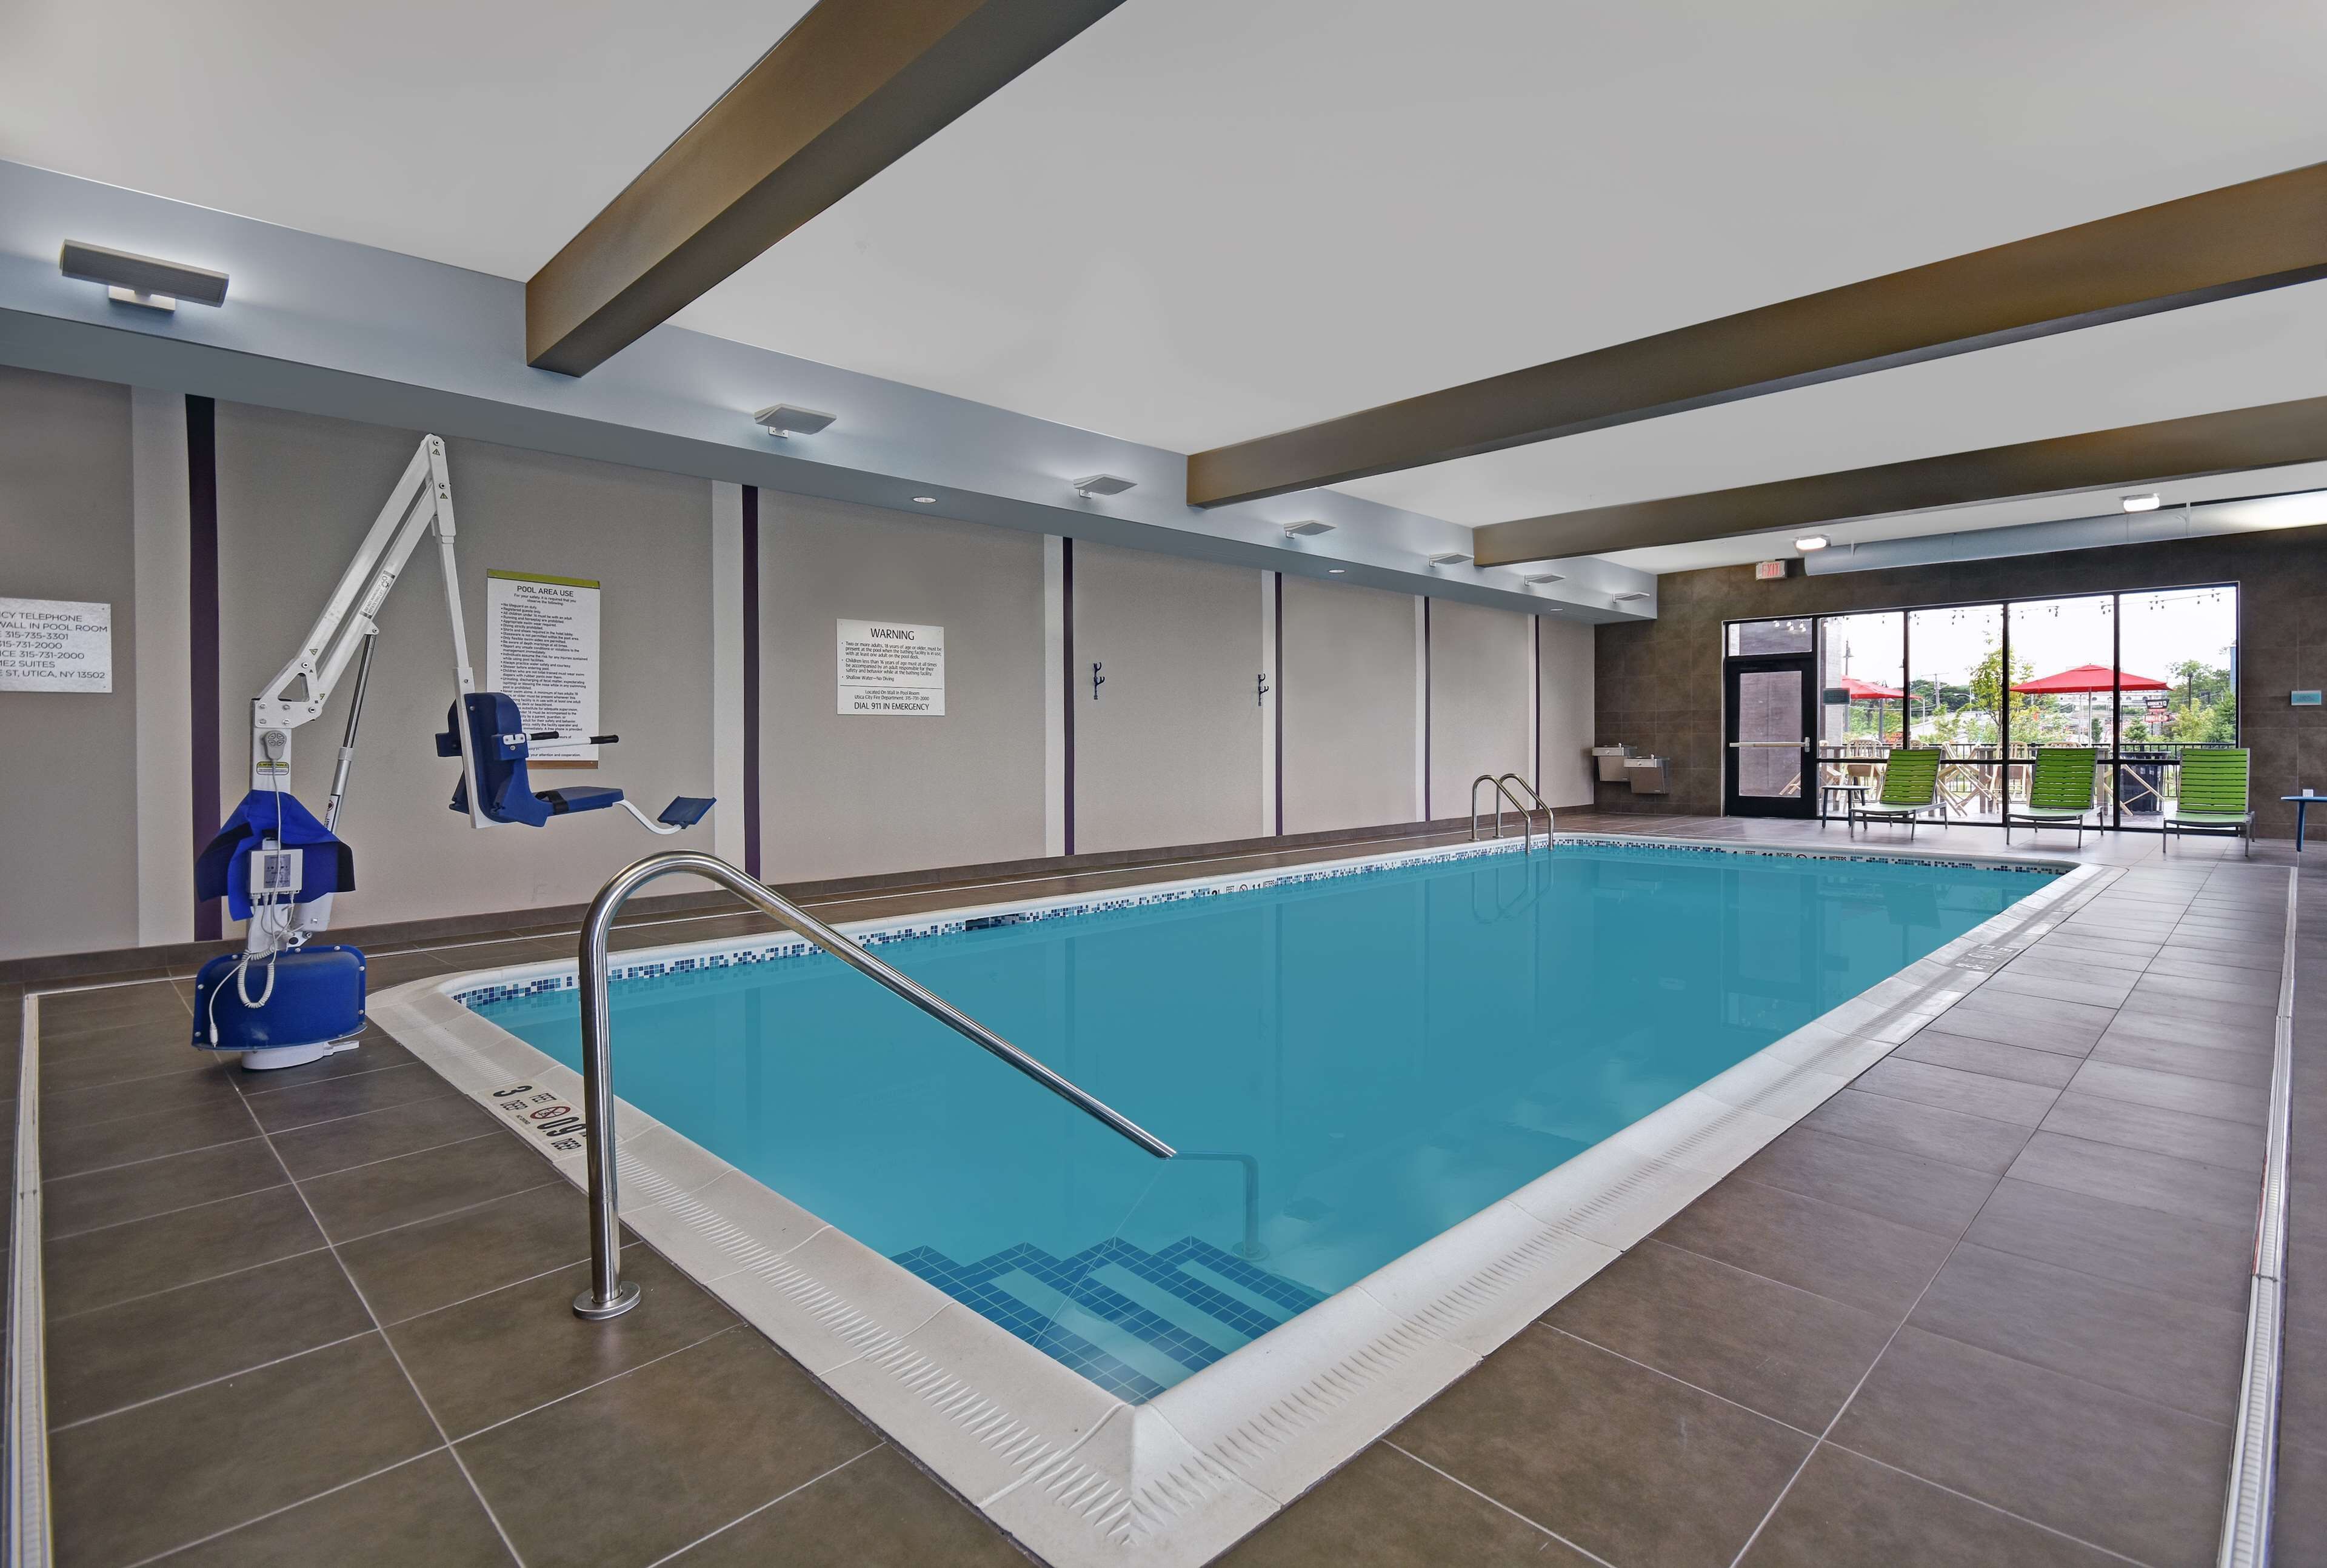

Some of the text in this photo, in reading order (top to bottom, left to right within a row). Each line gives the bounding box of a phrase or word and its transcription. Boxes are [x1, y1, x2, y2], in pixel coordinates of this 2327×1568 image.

[1762, 562, 1780, 576] EXIT
[19, 613, 82, 622] TELEPHONE
[5, 631, 68, 640] 315-735-3301
[870, 628, 915, 641] WARNING
[19, 651, 85, 659] 315-731-2000
[493, 1086, 533, 1097] 3
